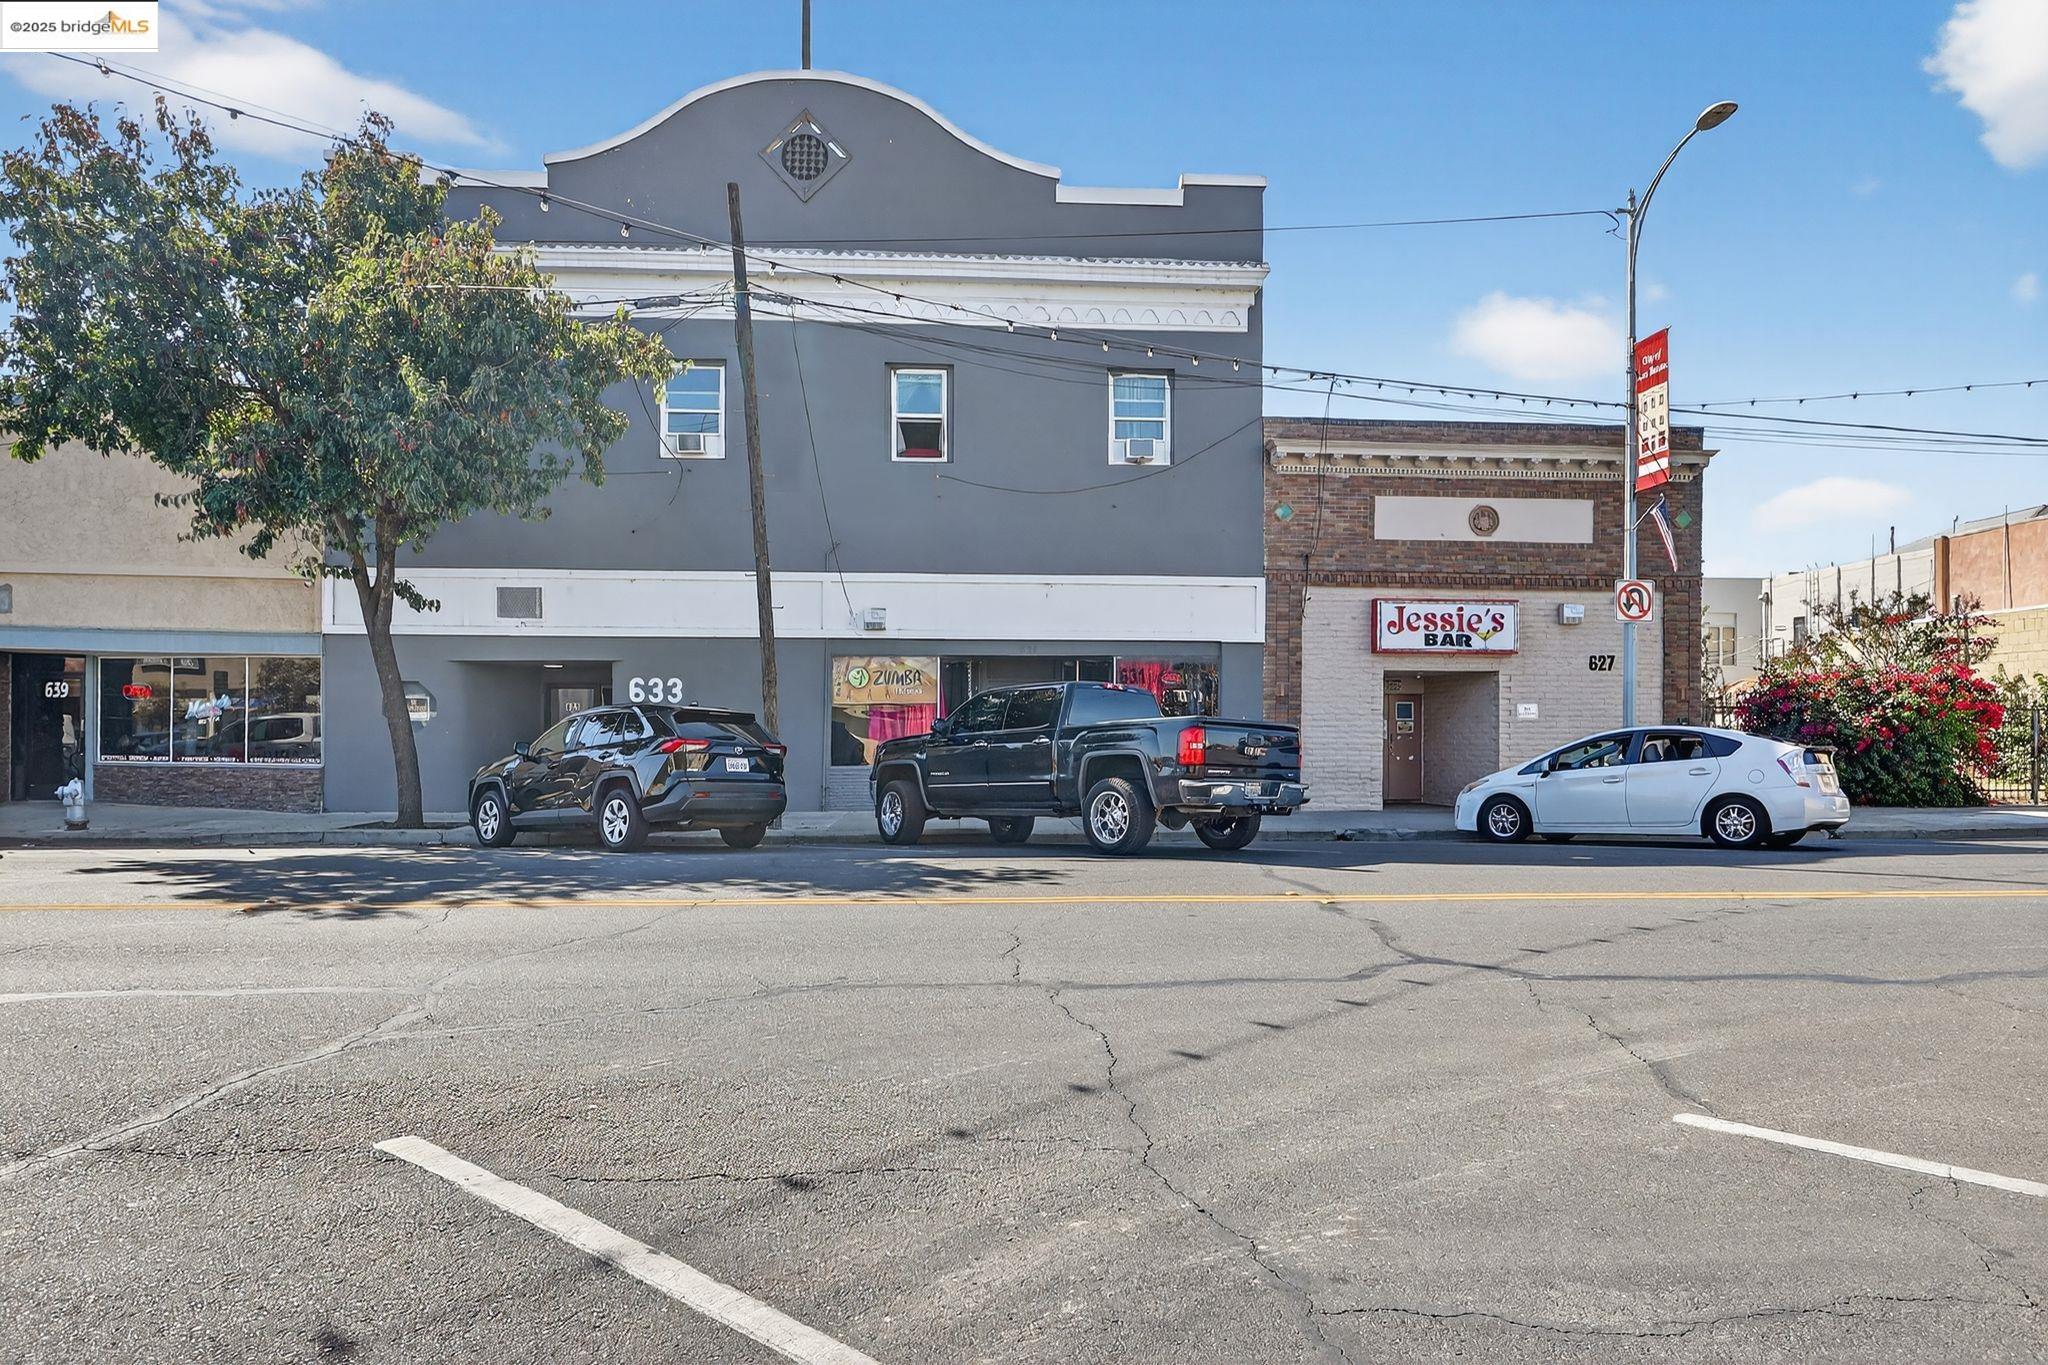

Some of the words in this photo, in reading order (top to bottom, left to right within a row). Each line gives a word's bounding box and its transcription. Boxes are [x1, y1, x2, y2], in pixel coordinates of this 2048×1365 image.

[1387, 605, 1505, 635] Jessie's
[1424, 633, 1473, 647] BAR
[1588, 654, 1616, 671] 627
[872, 669, 923, 686] ZUMBA
[44, 681, 69, 698] 639
[629, 677, 683, 704] 633
